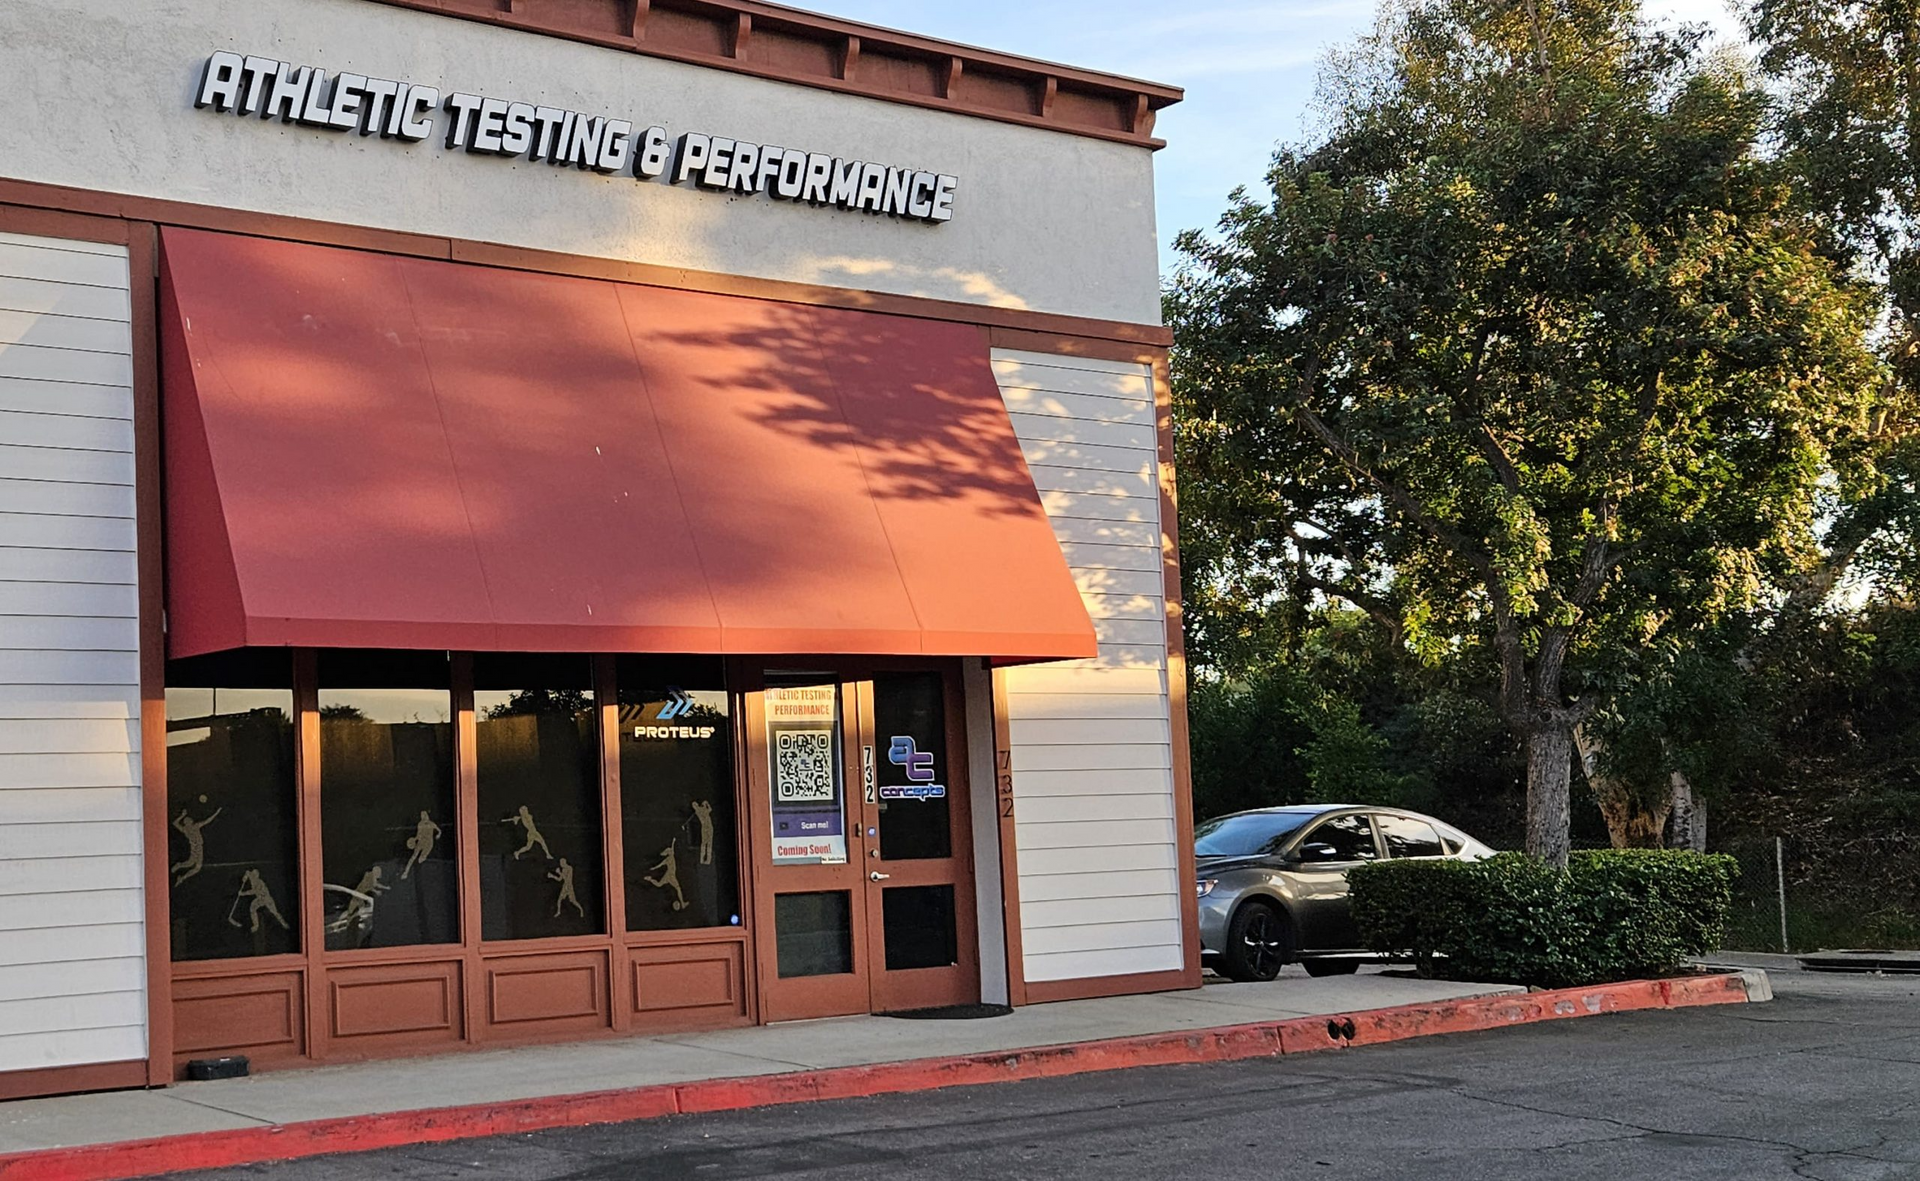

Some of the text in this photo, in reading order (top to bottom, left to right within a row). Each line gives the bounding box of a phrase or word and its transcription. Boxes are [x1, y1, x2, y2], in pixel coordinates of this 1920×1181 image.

[196, 50, 958, 224] ATHLETIC TESTING & PERFORMANCE
[800, 689, 832, 700] TESTING
[774, 704, 830, 715] PERFORMANCE
[634, 726, 712, 738] PROTEUS
[864, 747, 874, 803] 732
[801, 821, 816, 829] Scan
[777, 843, 831, 856] Coming Soon!
